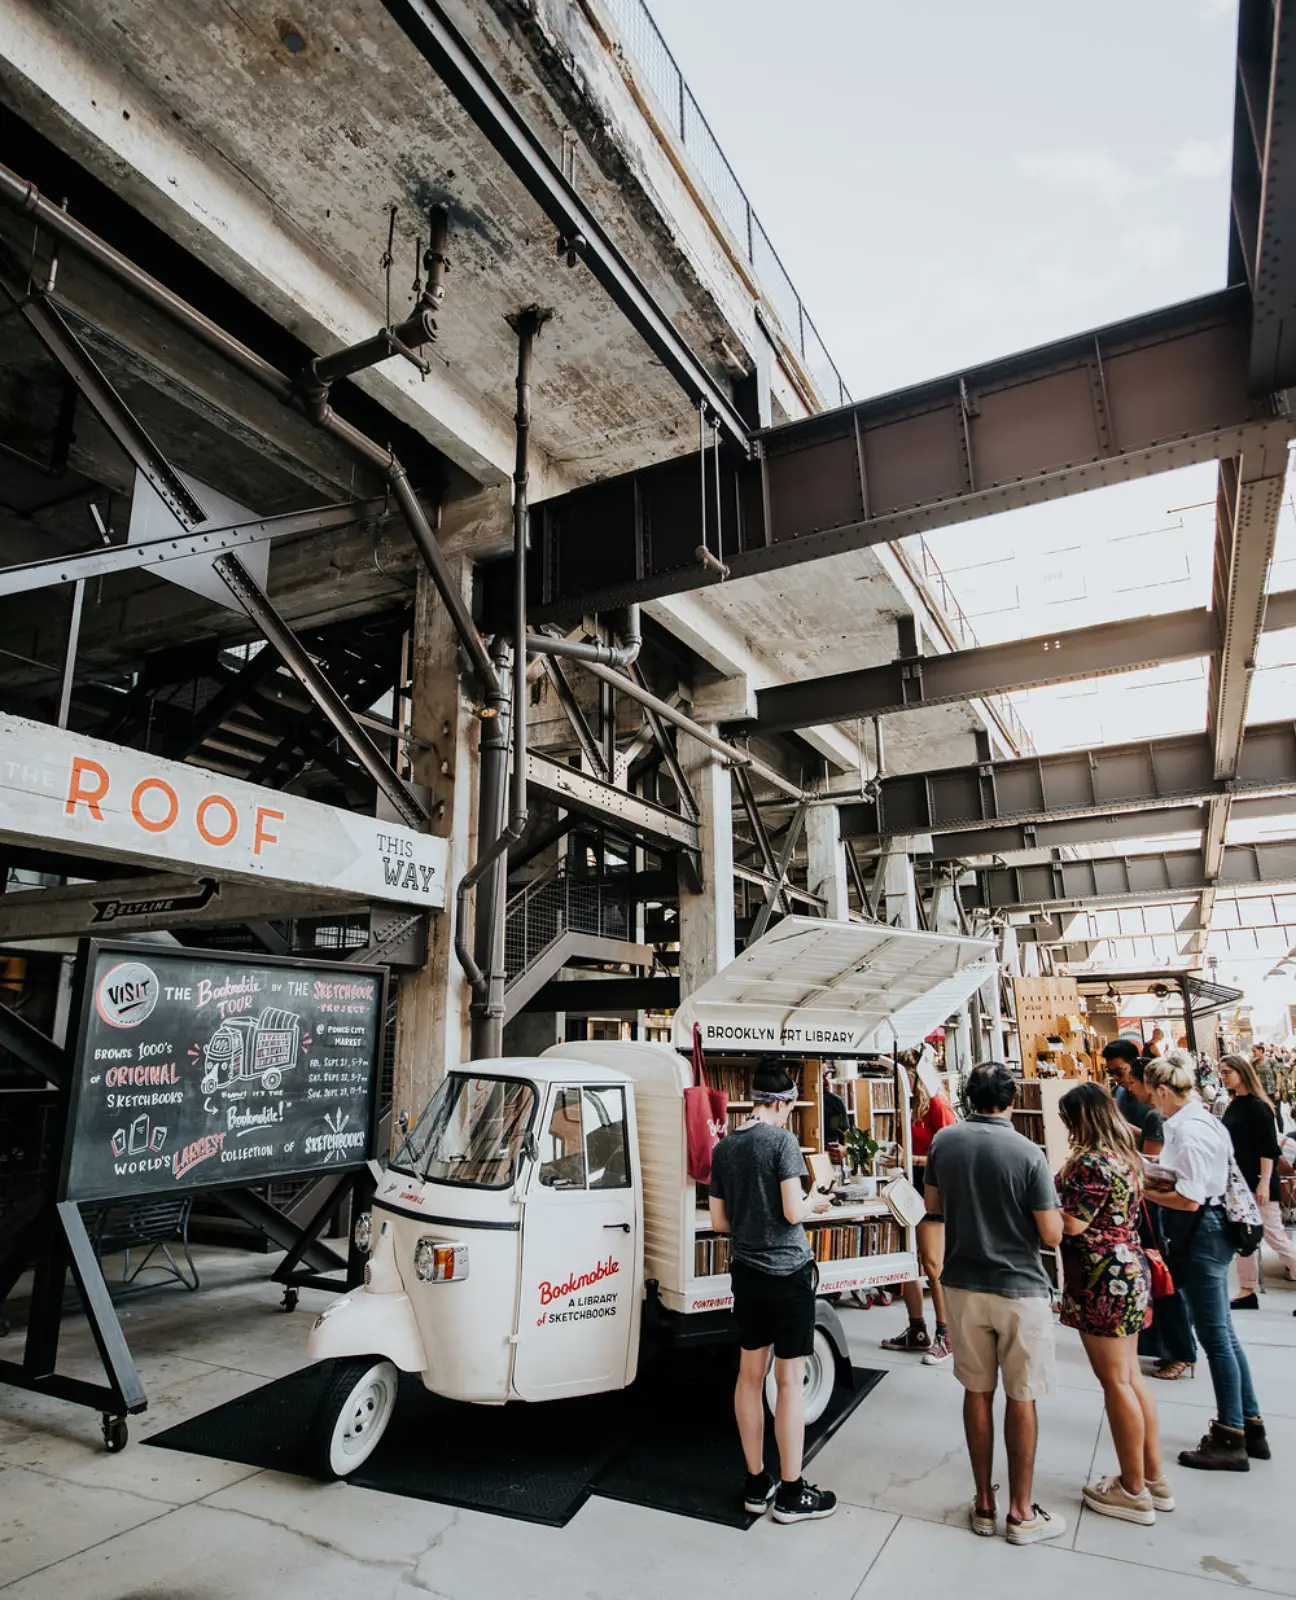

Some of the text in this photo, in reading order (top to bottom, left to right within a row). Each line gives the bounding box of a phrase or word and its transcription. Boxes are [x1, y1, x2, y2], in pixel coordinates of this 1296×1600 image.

[5, 756, 285, 855] THE ROOF
[377, 833, 413, 858] THIS
[383, 856, 435, 893] WAY
[107, 975, 375, 1010] VISIT THE Bookmobile BY THE SKETCHBOOK
[217, 995, 253, 1019] TOUR
[316, 1024, 325, 1035] @
[327, 1026, 349, 1034] PONCE
[706, 1025, 854, 1043] BROOKLYN ART LIBRARY
[94, 1048, 133, 1060] BROWSE
[334, 1037, 362, 1047] MARKET
[105, 1062, 182, 1087] ORIGINAL
[107, 1091, 184, 1108] SKETCHBOOKS
[114, 1131, 365, 1175] WORLD'S LARGEST COLLECTION OF SKETCHBOOKS
[538, 1255, 620, 1305] Bookmobile
[568, 1292, 619, 1307] A LIBRARY
[536, 1306, 617, 1327] of SKETCHBOOKS
